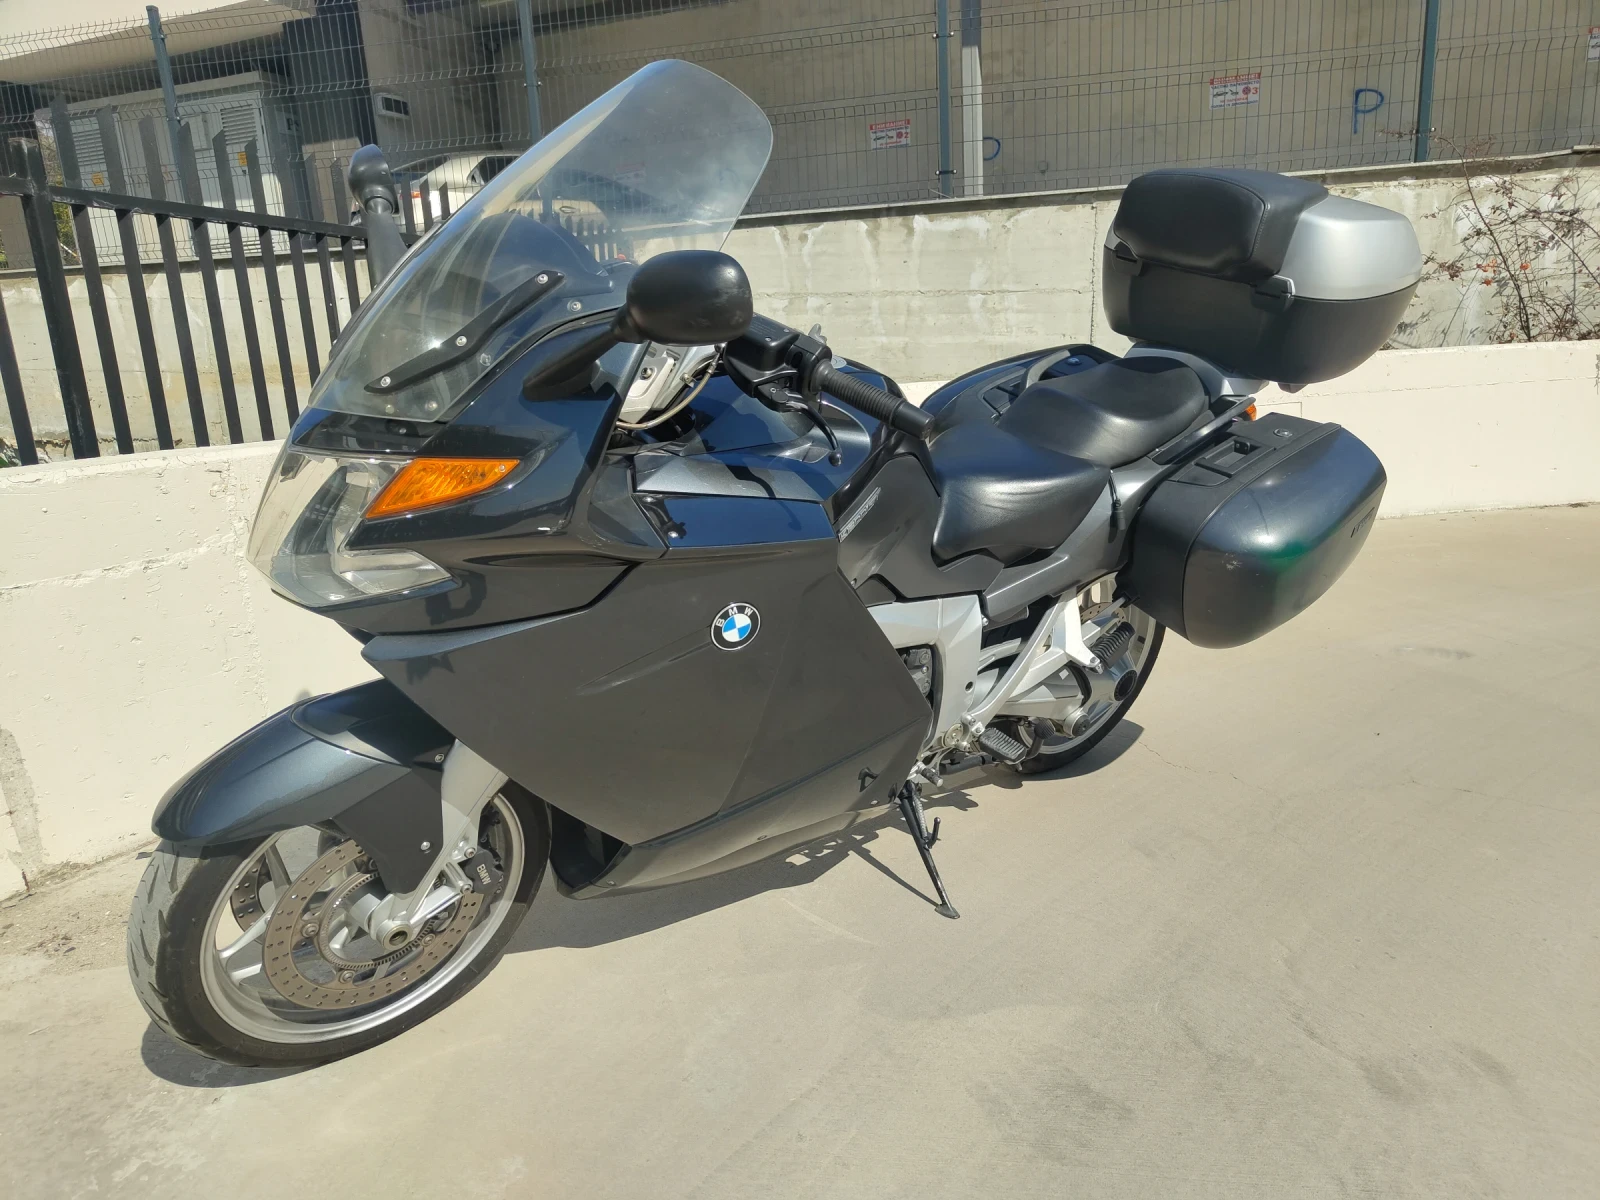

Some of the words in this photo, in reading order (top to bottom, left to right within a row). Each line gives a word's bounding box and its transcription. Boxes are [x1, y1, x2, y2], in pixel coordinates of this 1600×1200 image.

[1252, 87, 1258, 95] 3
[1353, 88, 1385, 135] P
[904, 131, 909, 139] 2
[715, 606, 754, 628] BMW
[476, 863, 492, 885] BMW
